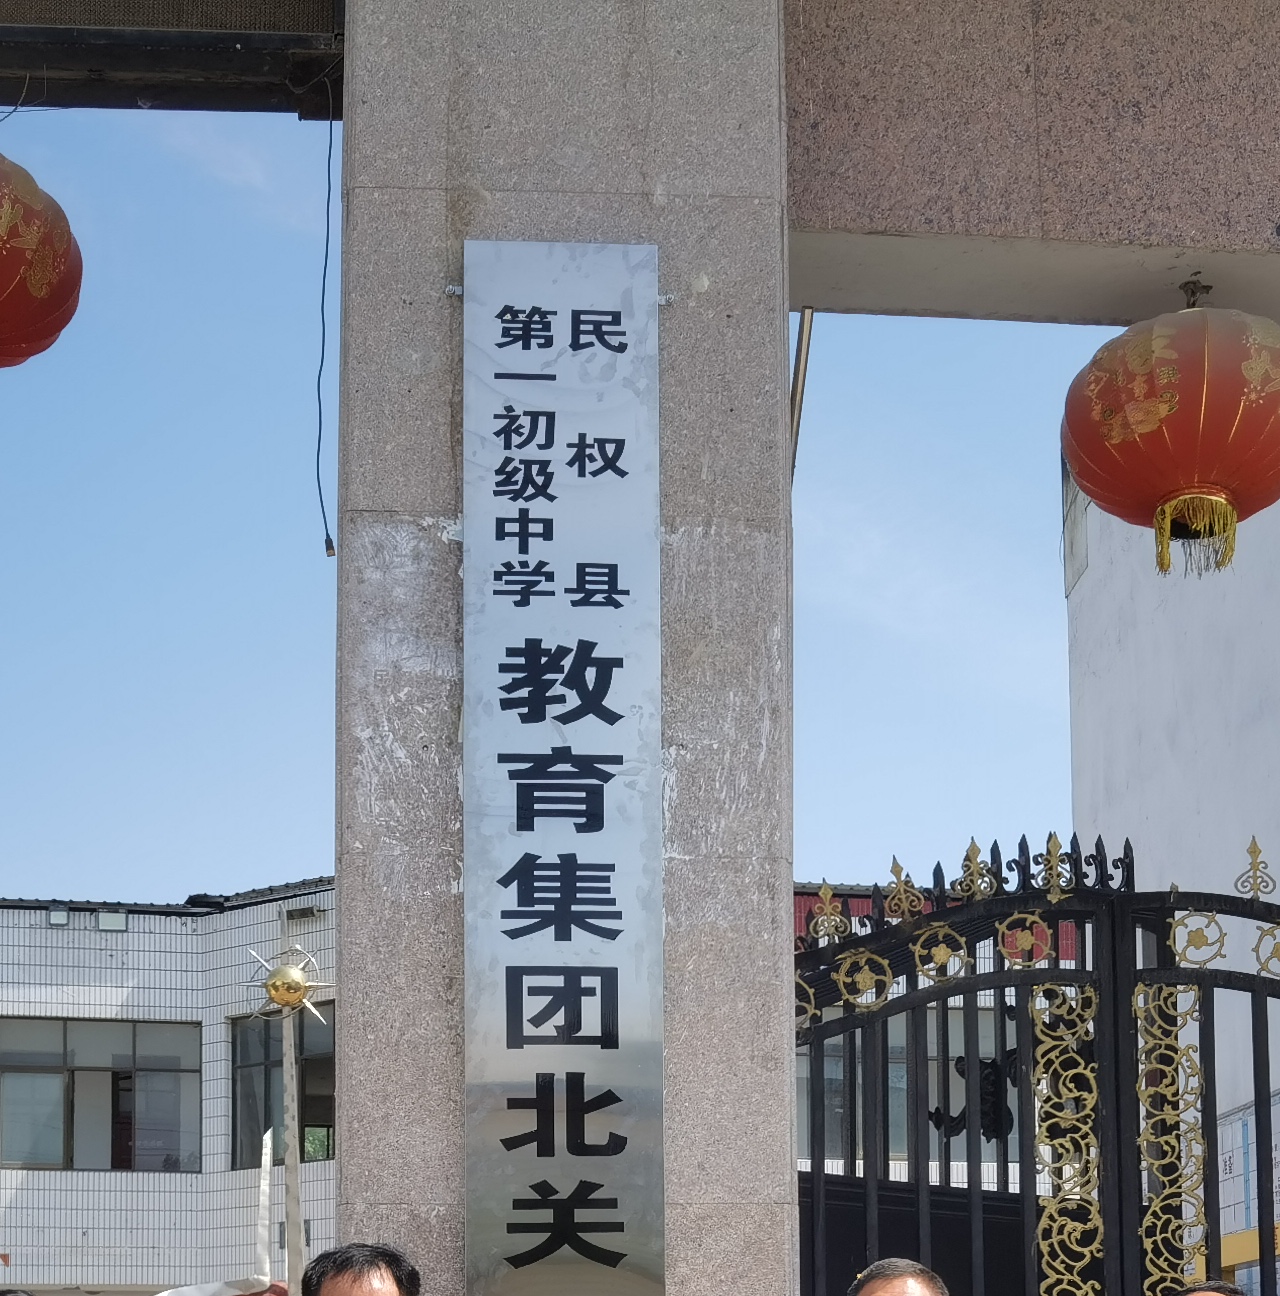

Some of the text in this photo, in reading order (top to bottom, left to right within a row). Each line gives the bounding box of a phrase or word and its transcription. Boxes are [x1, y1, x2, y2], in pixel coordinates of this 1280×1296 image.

[493, 305, 558, 607] 第一初级中学
[564, 310, 630, 609] 民权县
